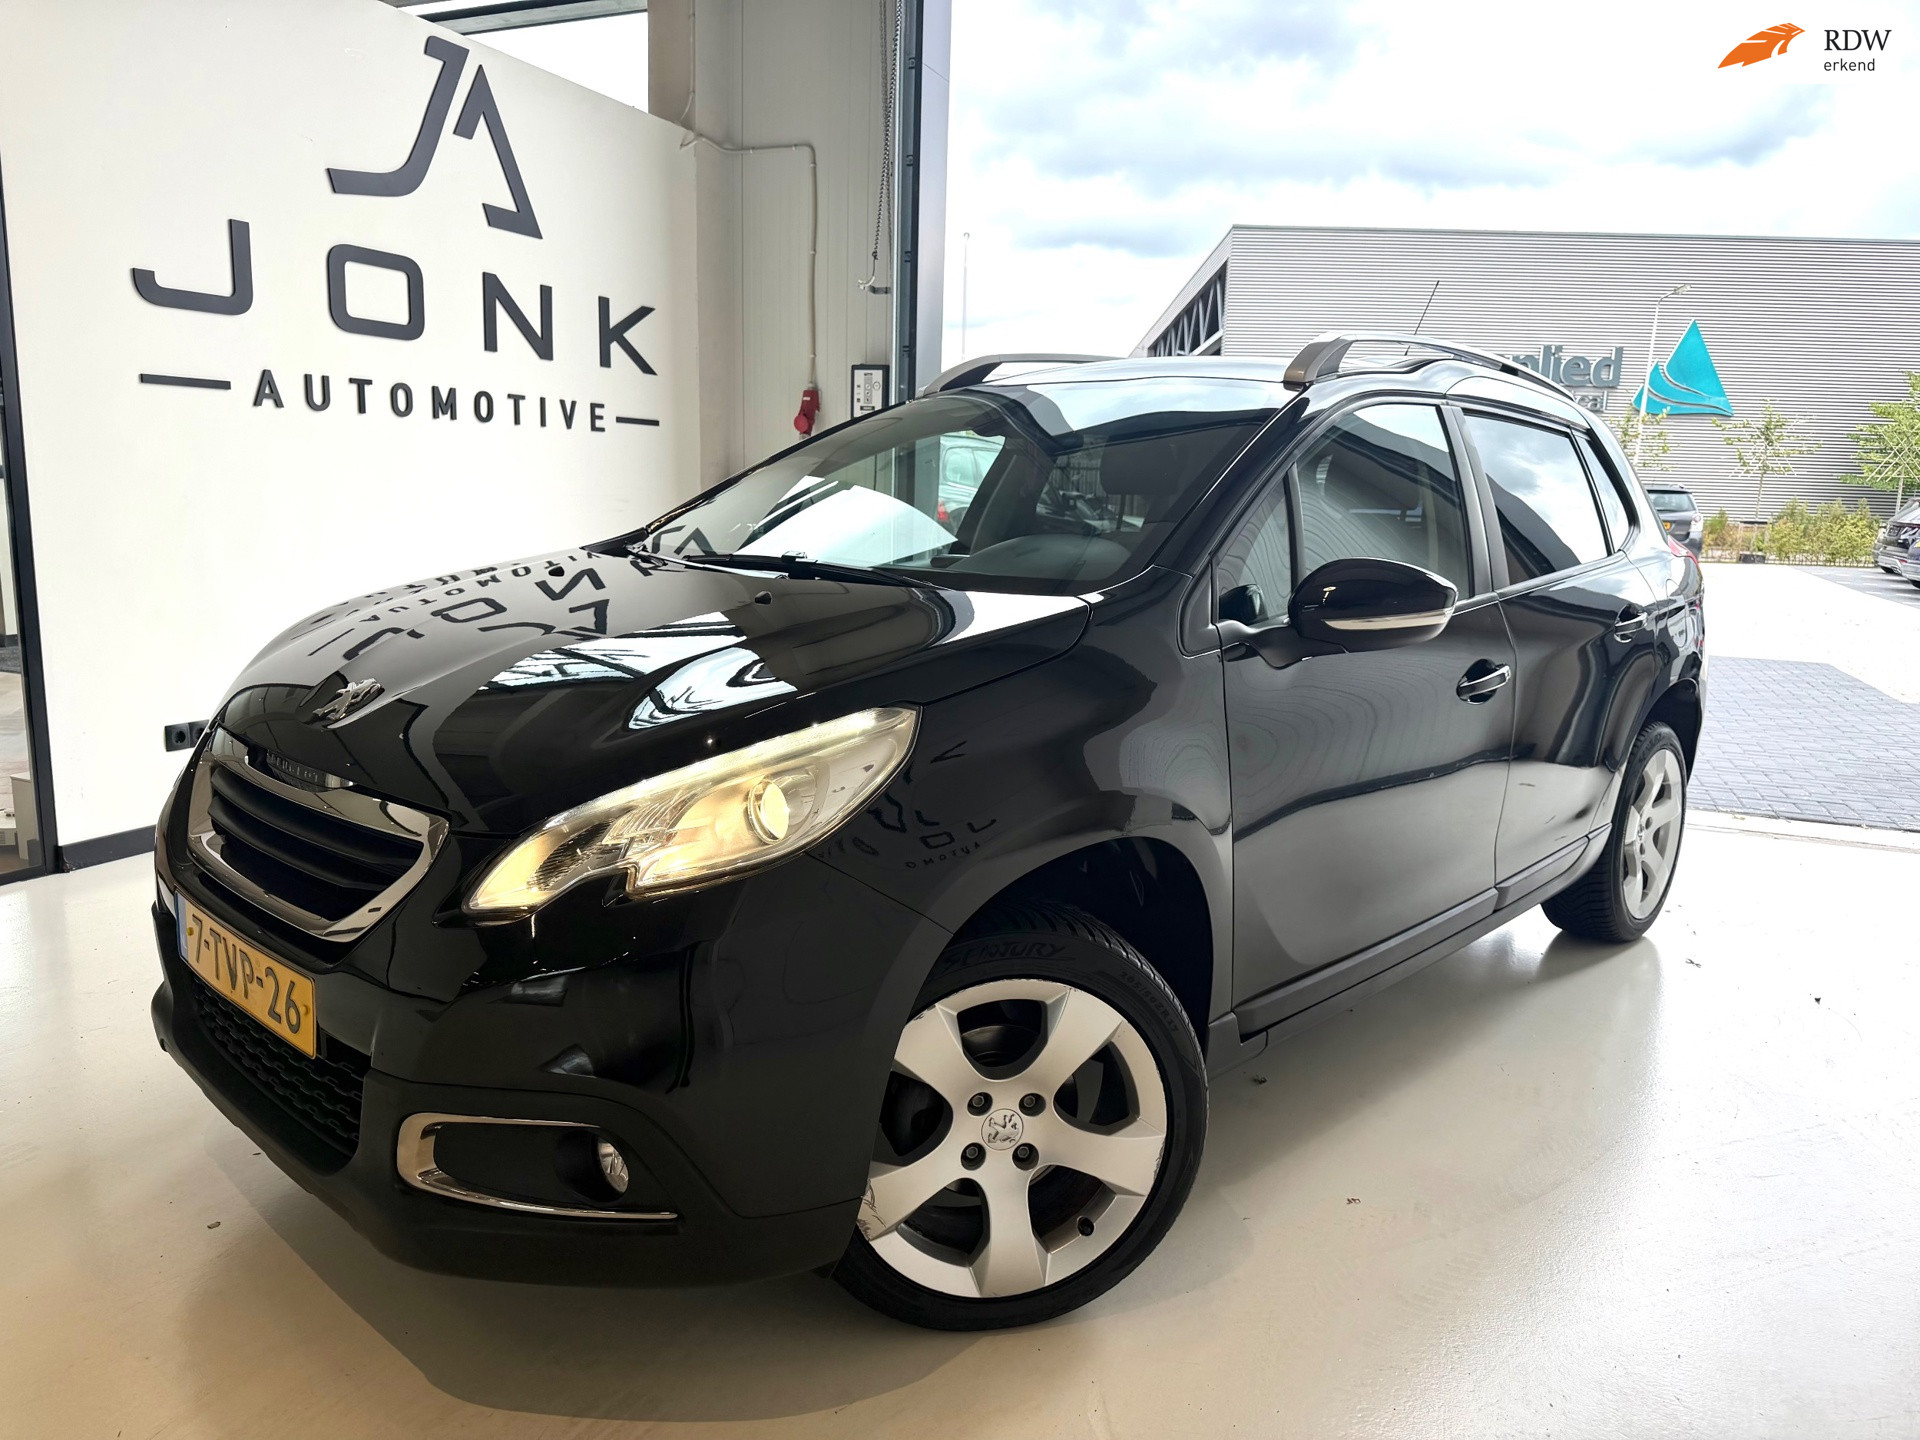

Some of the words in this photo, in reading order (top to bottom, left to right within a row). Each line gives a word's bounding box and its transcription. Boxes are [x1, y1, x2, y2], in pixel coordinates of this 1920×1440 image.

[131, 218, 658, 376] JONK
[253, 368, 607, 433] AUTOMOTIVE
[192, 913, 300, 1034] 7-TVP-26
